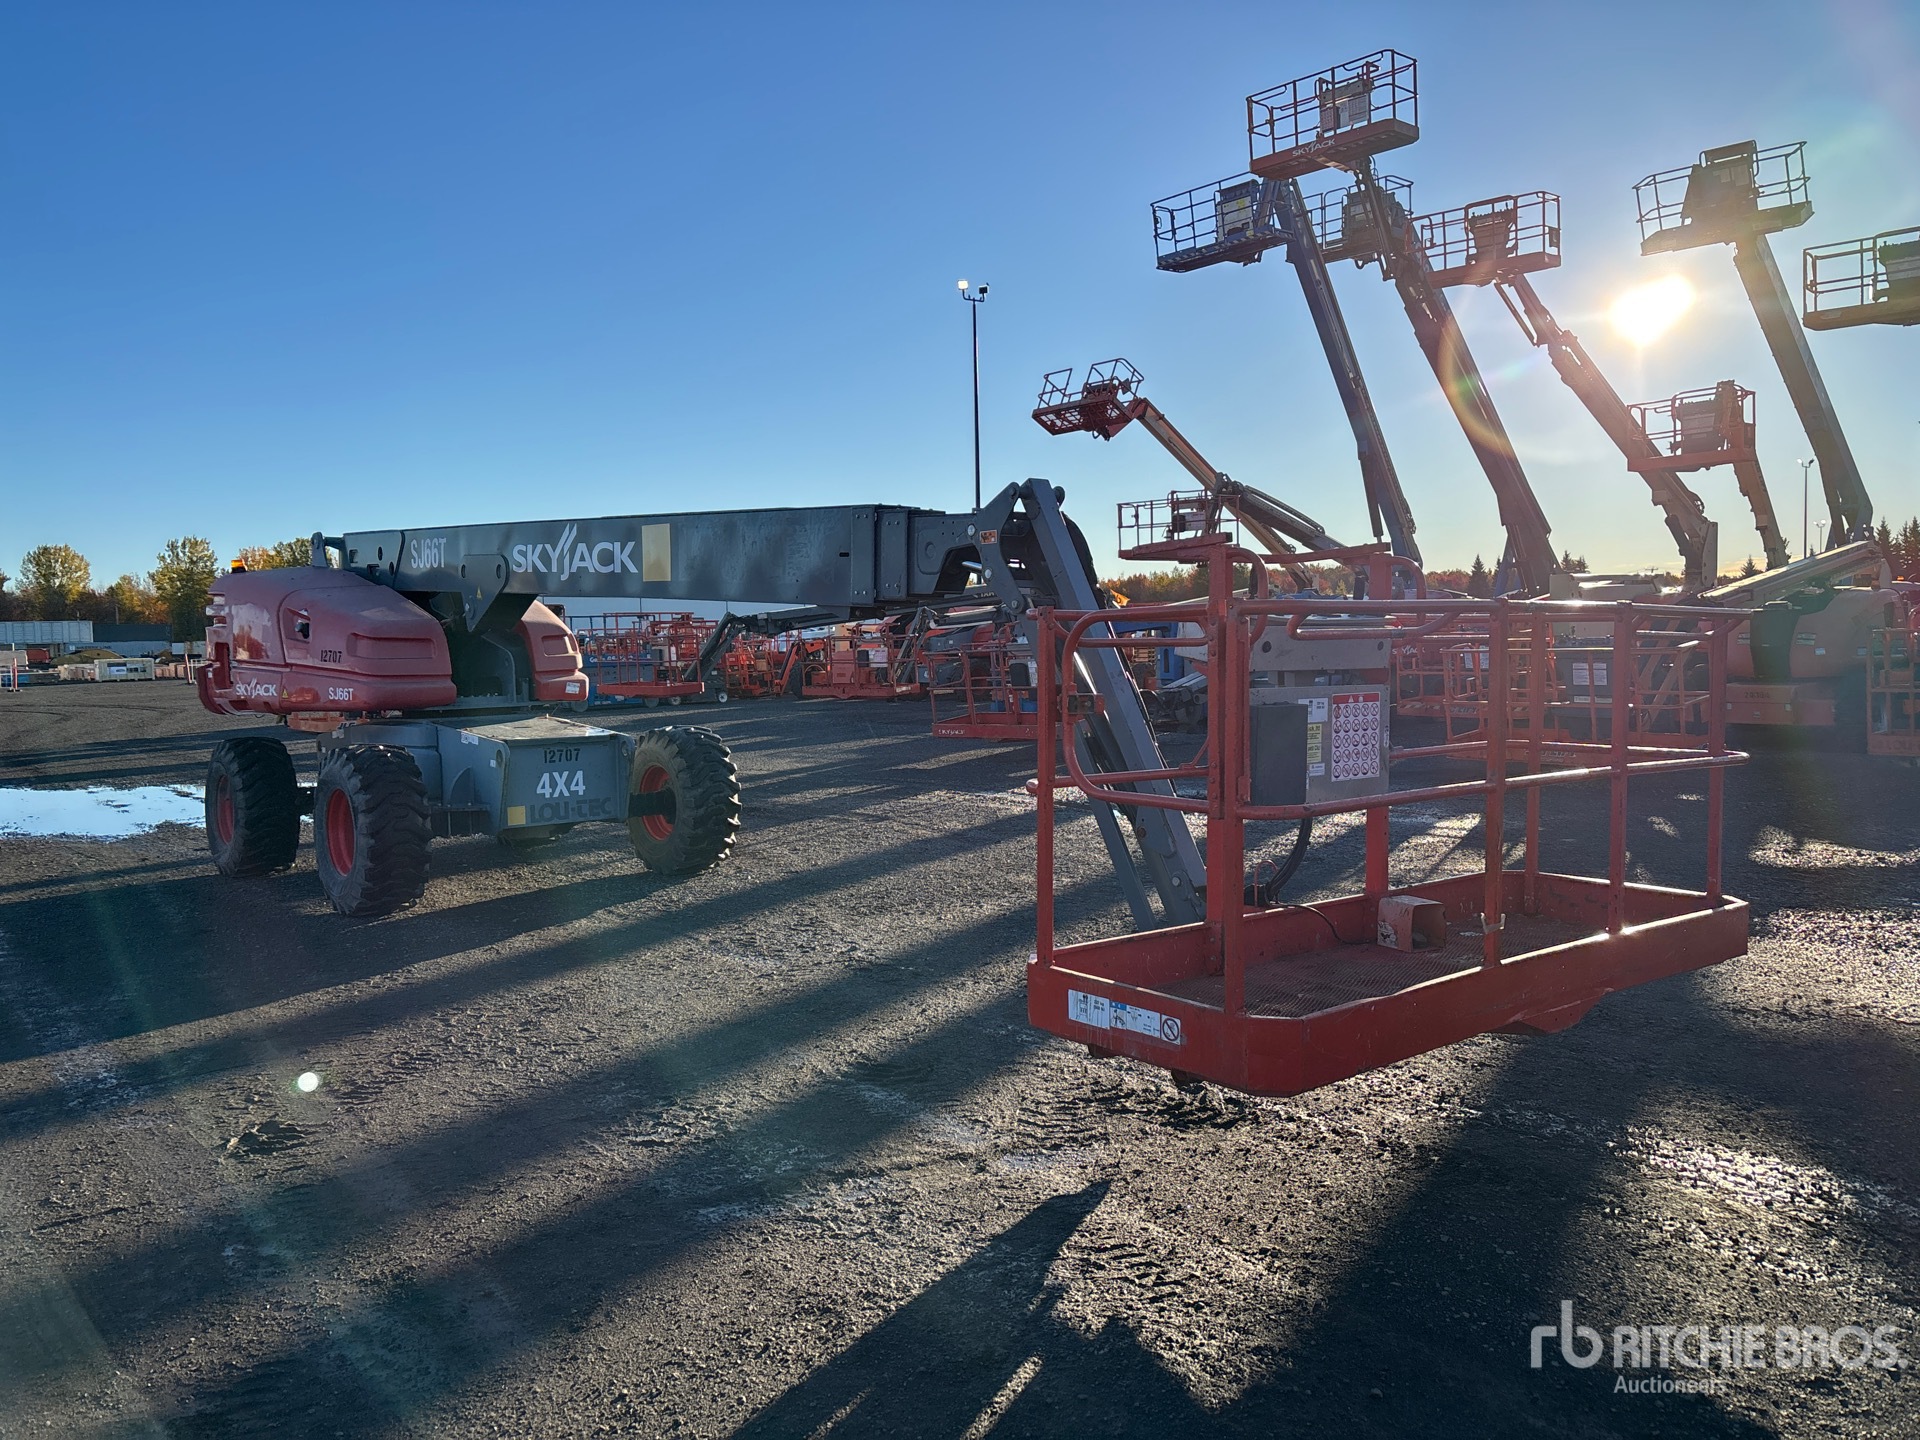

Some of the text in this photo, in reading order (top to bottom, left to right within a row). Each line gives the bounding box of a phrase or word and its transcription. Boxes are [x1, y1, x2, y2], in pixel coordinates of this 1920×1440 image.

[1292, 138, 1336, 157] SKYJACK
[410, 537, 447, 569] SJ66T
[512, 523, 639, 581] SKYJACK
[320, 649, 342, 663] 12707
[1391, 645, 1426, 655] SYJACK
[235, 677, 277, 699] SKYJACK
[328, 687, 354, 701] SJ66T
[543, 748, 581, 764] 12707
[536, 770, 586, 798] 4X4
[529, 796, 613, 824] LOU-TEC
